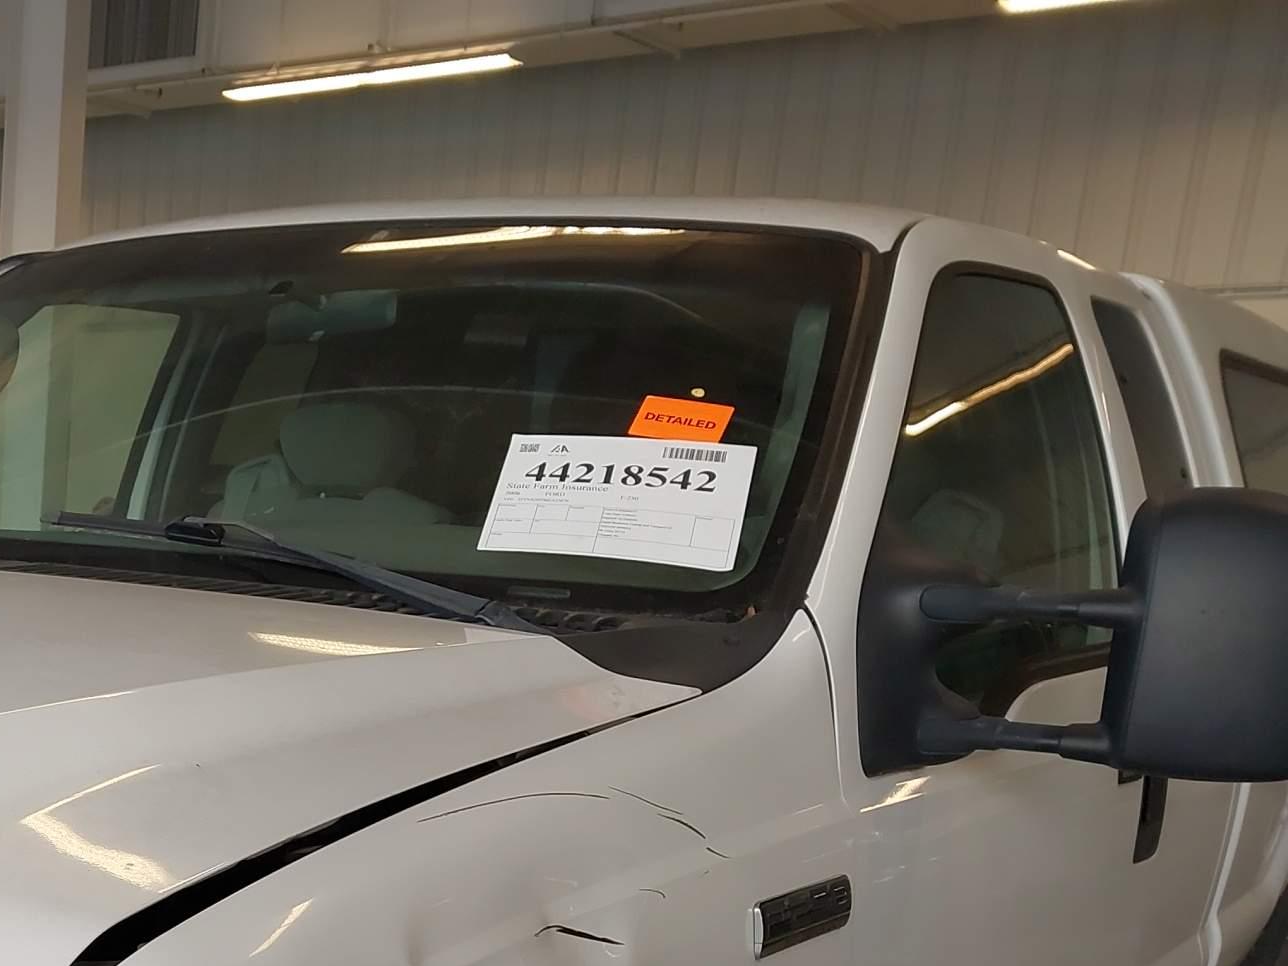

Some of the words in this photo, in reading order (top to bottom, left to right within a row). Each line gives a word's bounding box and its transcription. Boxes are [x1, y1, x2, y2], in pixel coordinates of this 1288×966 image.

[643, 411, 717, 430] DETAILED
[524, 461, 718, 493] 44218542
[506, 482, 531, 490] State
[533, 482, 559, 490] Farm
[561, 482, 609, 493] Insurance
